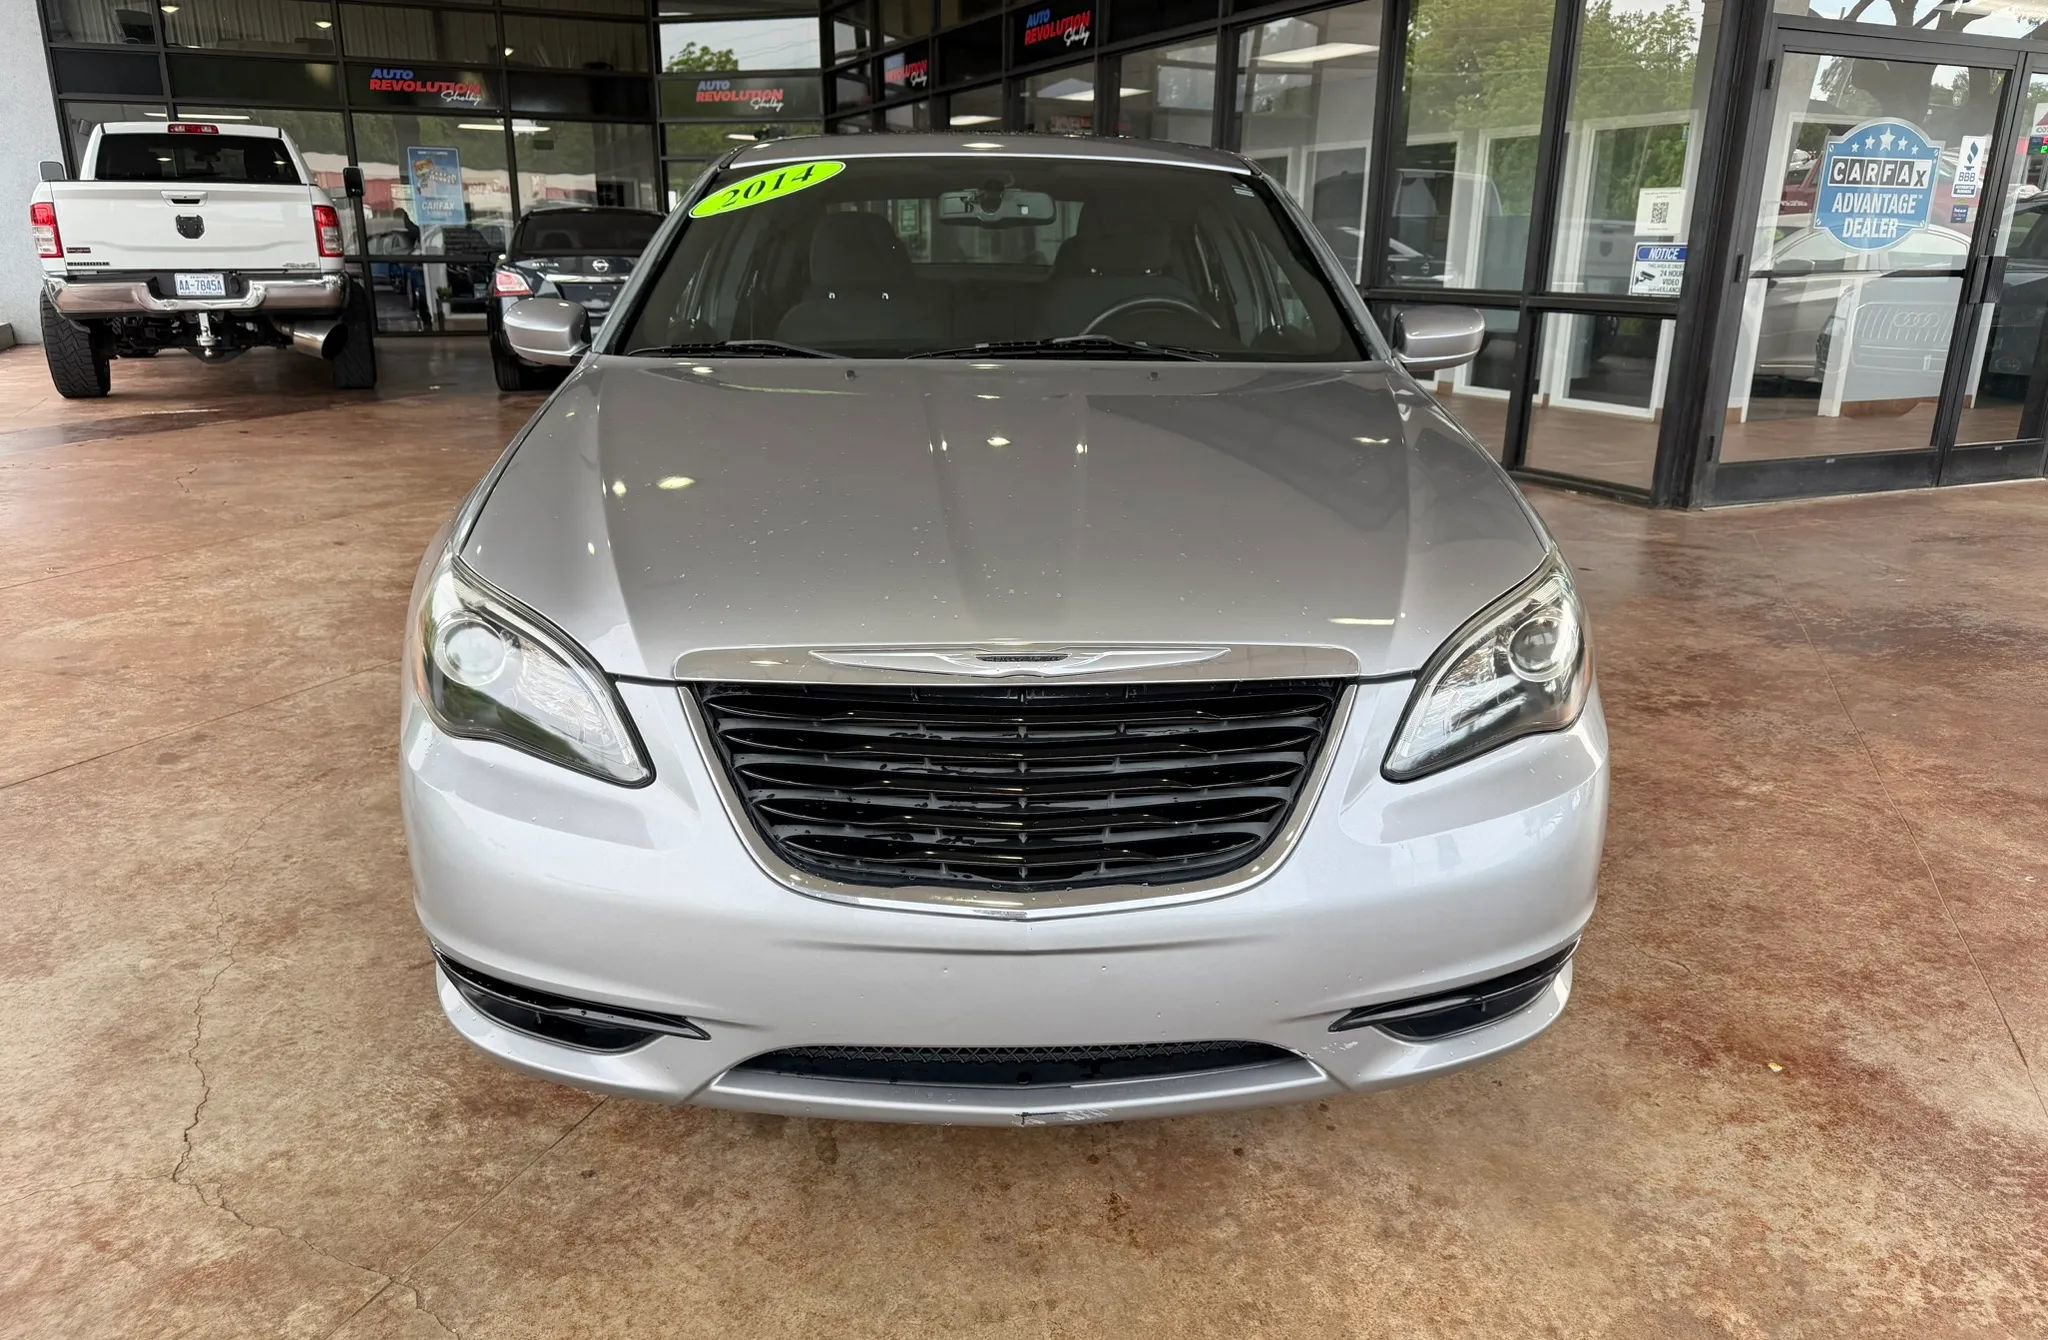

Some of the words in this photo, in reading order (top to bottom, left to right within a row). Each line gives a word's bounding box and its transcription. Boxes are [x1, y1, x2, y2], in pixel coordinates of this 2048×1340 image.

[1026, 8, 1051, 28] AUTO
[1025, 10, 1091, 47] REVOLUTION
[1063, 23, 1090, 47] Shelby
[371, 68, 414, 79] AUTO
[369, 79, 481, 93] REVOLUTION
[697, 81, 731, 91] AUTO
[440, 90, 482, 106] Shelby
[695, 89, 784, 103] REVOLUTION
[749, 96, 784, 112] Shelby
[1832, 161, 1928, 188] CARFAX
[1958, 172, 1976, 182] BBB
[720, 164, 816, 208] 2014
[421, 201, 455, 211] CARFAX
[1842, 218, 1899, 239] DEALER
[1648, 246, 1681, 260] NOTICE
[1660, 269, 1668, 278] 24
